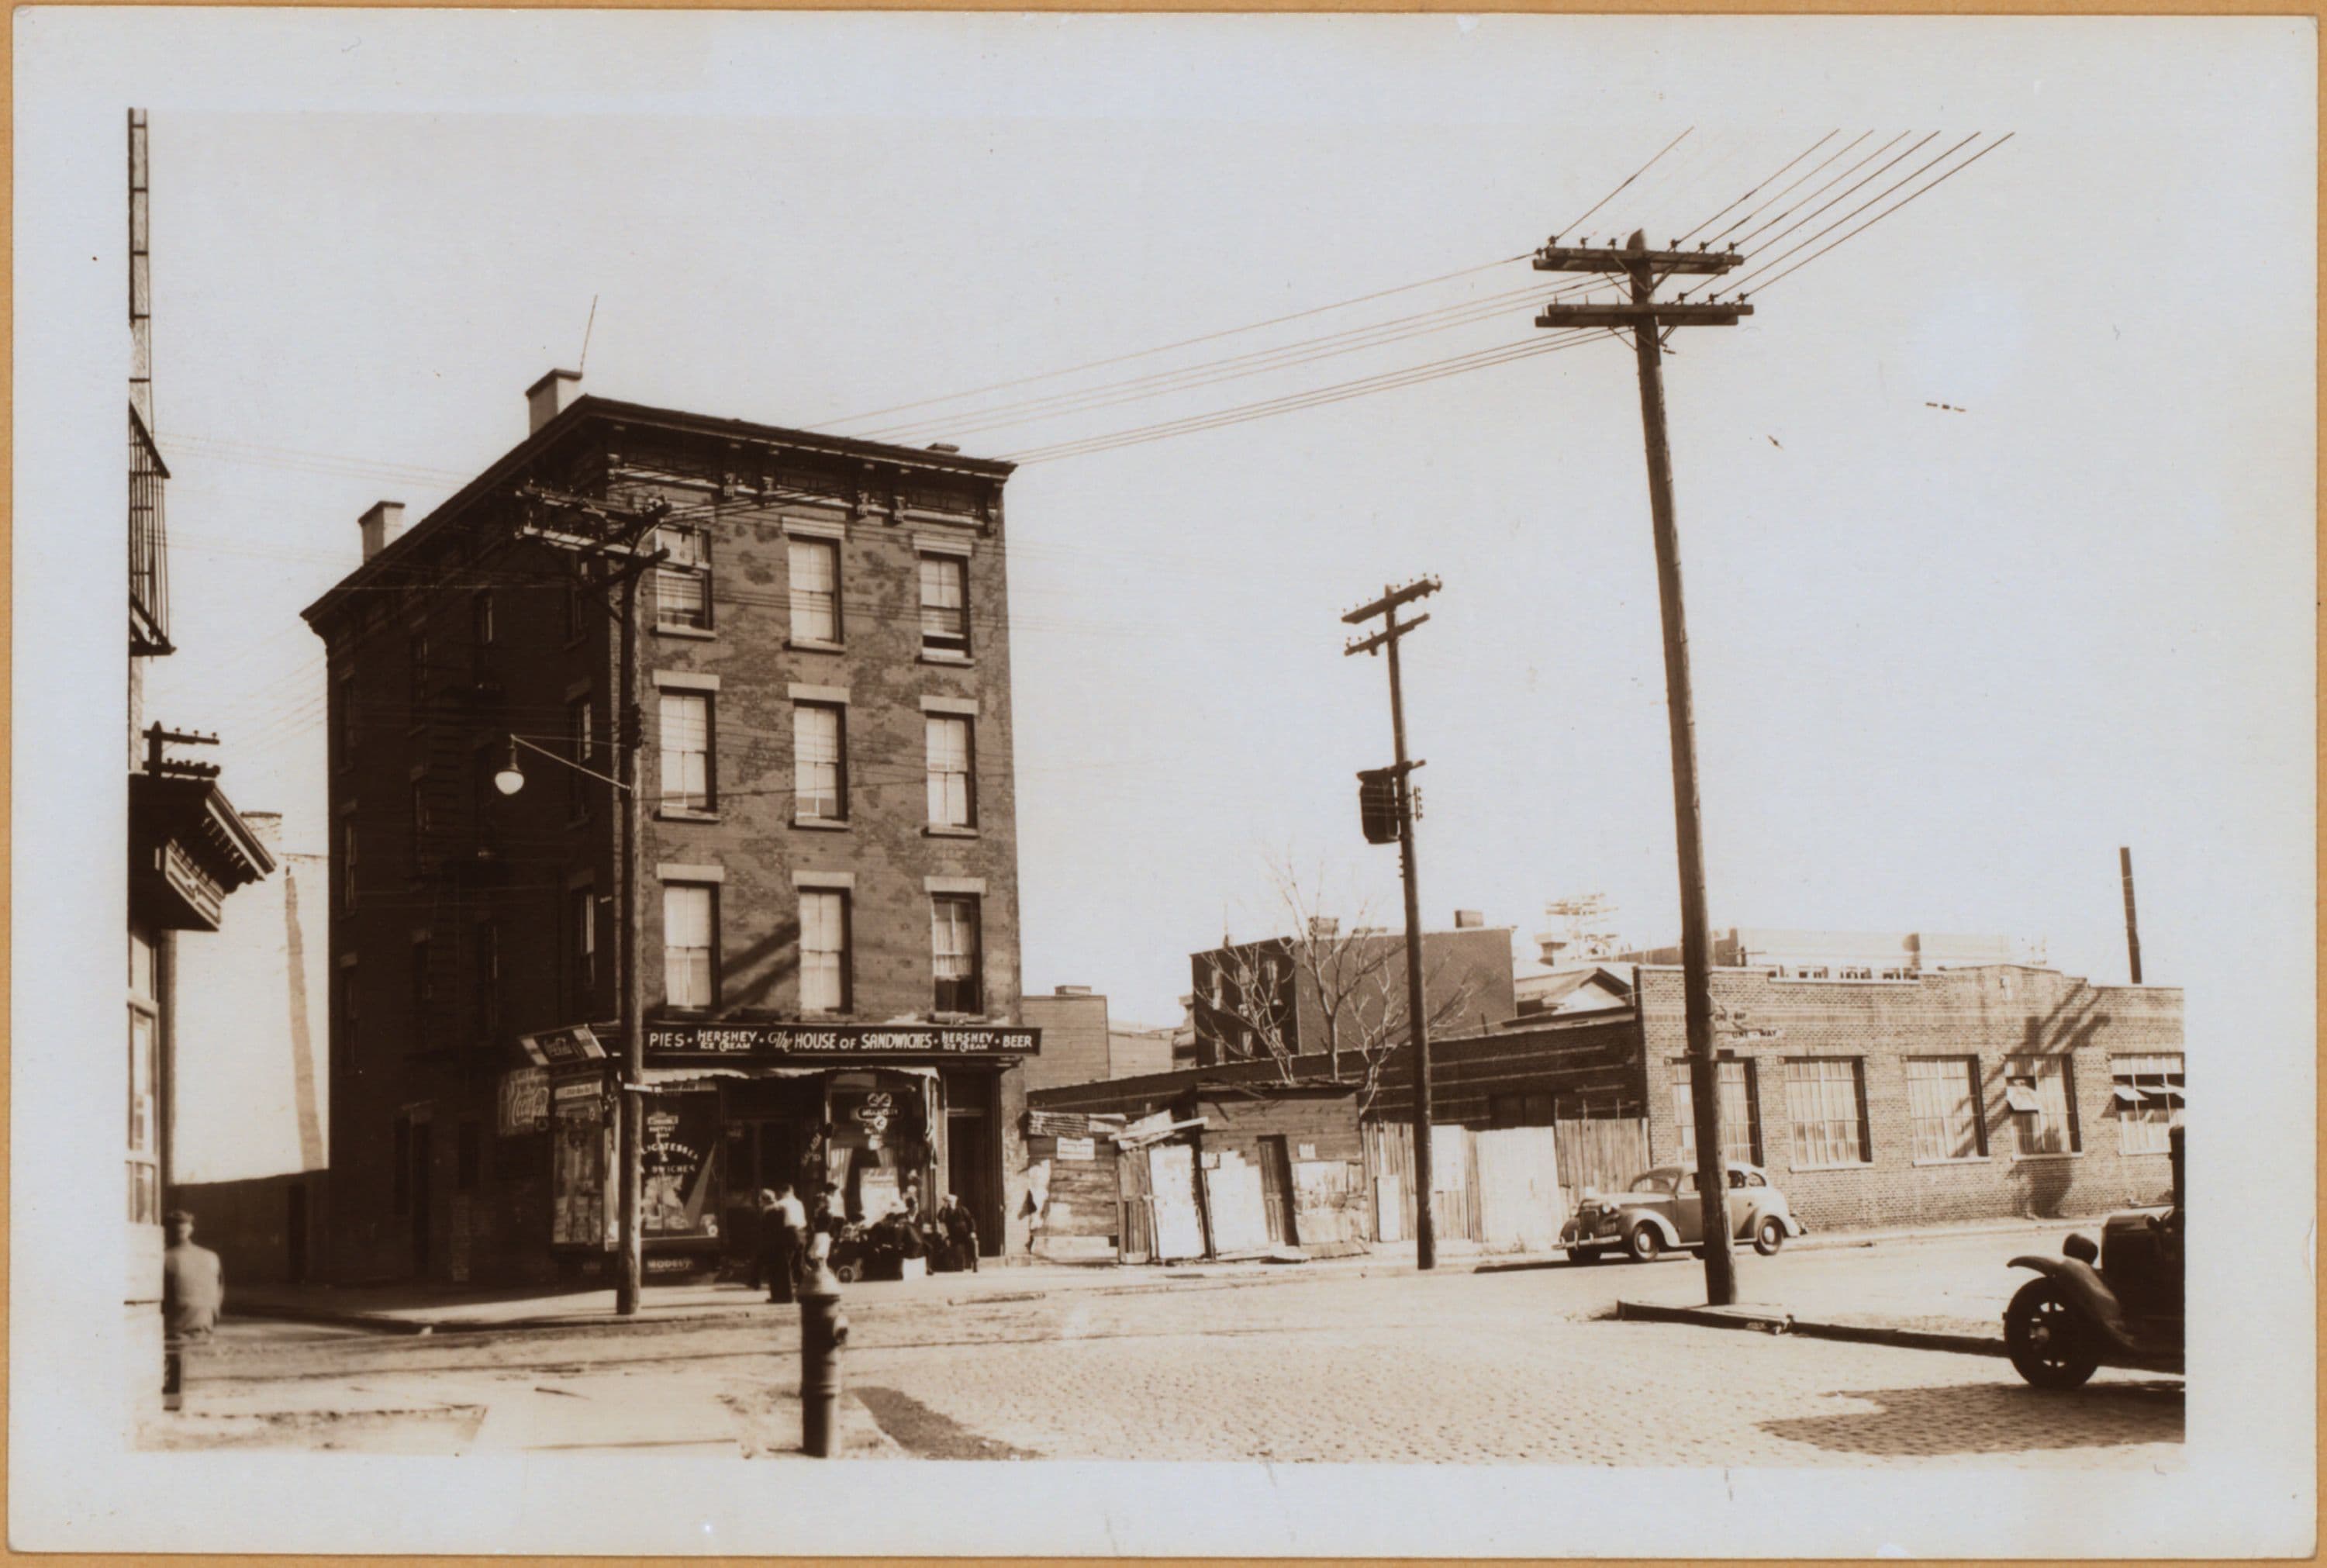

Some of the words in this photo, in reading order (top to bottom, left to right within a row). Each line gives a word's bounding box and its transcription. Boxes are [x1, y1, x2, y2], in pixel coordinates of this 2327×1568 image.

[649, 1033, 685, 1047] PIES
[696, 1030, 758, 1043] HERSHEY
[794, 1033, 837, 1049] HOUSE
[861, 1033, 933, 1049] SANDWICHES
[941, 1031, 995, 1043] HERSHEY
[1002, 1034, 1033, 1048] BEER
